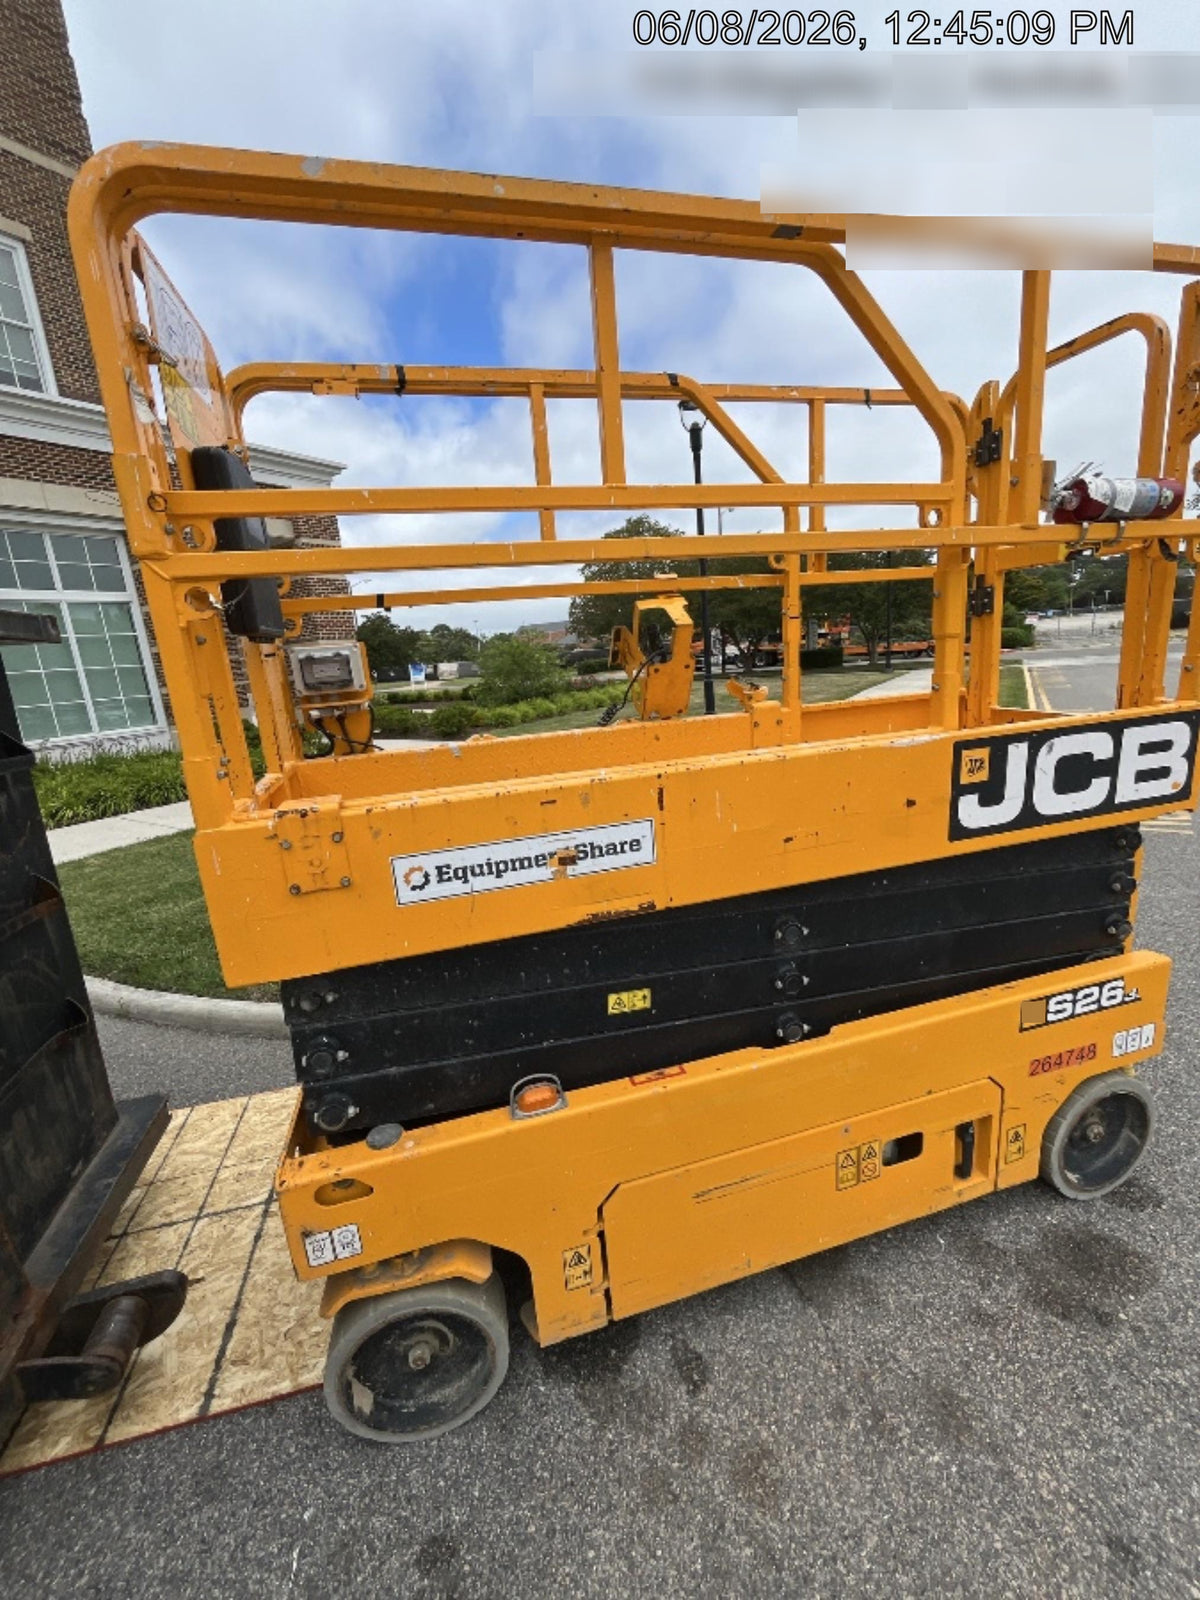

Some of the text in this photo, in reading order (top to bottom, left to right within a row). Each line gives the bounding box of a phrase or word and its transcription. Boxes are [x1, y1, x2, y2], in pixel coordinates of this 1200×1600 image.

[957, 721, 1192, 829] JCB
[435, 838, 643, 884] EquipmeShare
[1029, 1043, 1097, 1077] 264748
